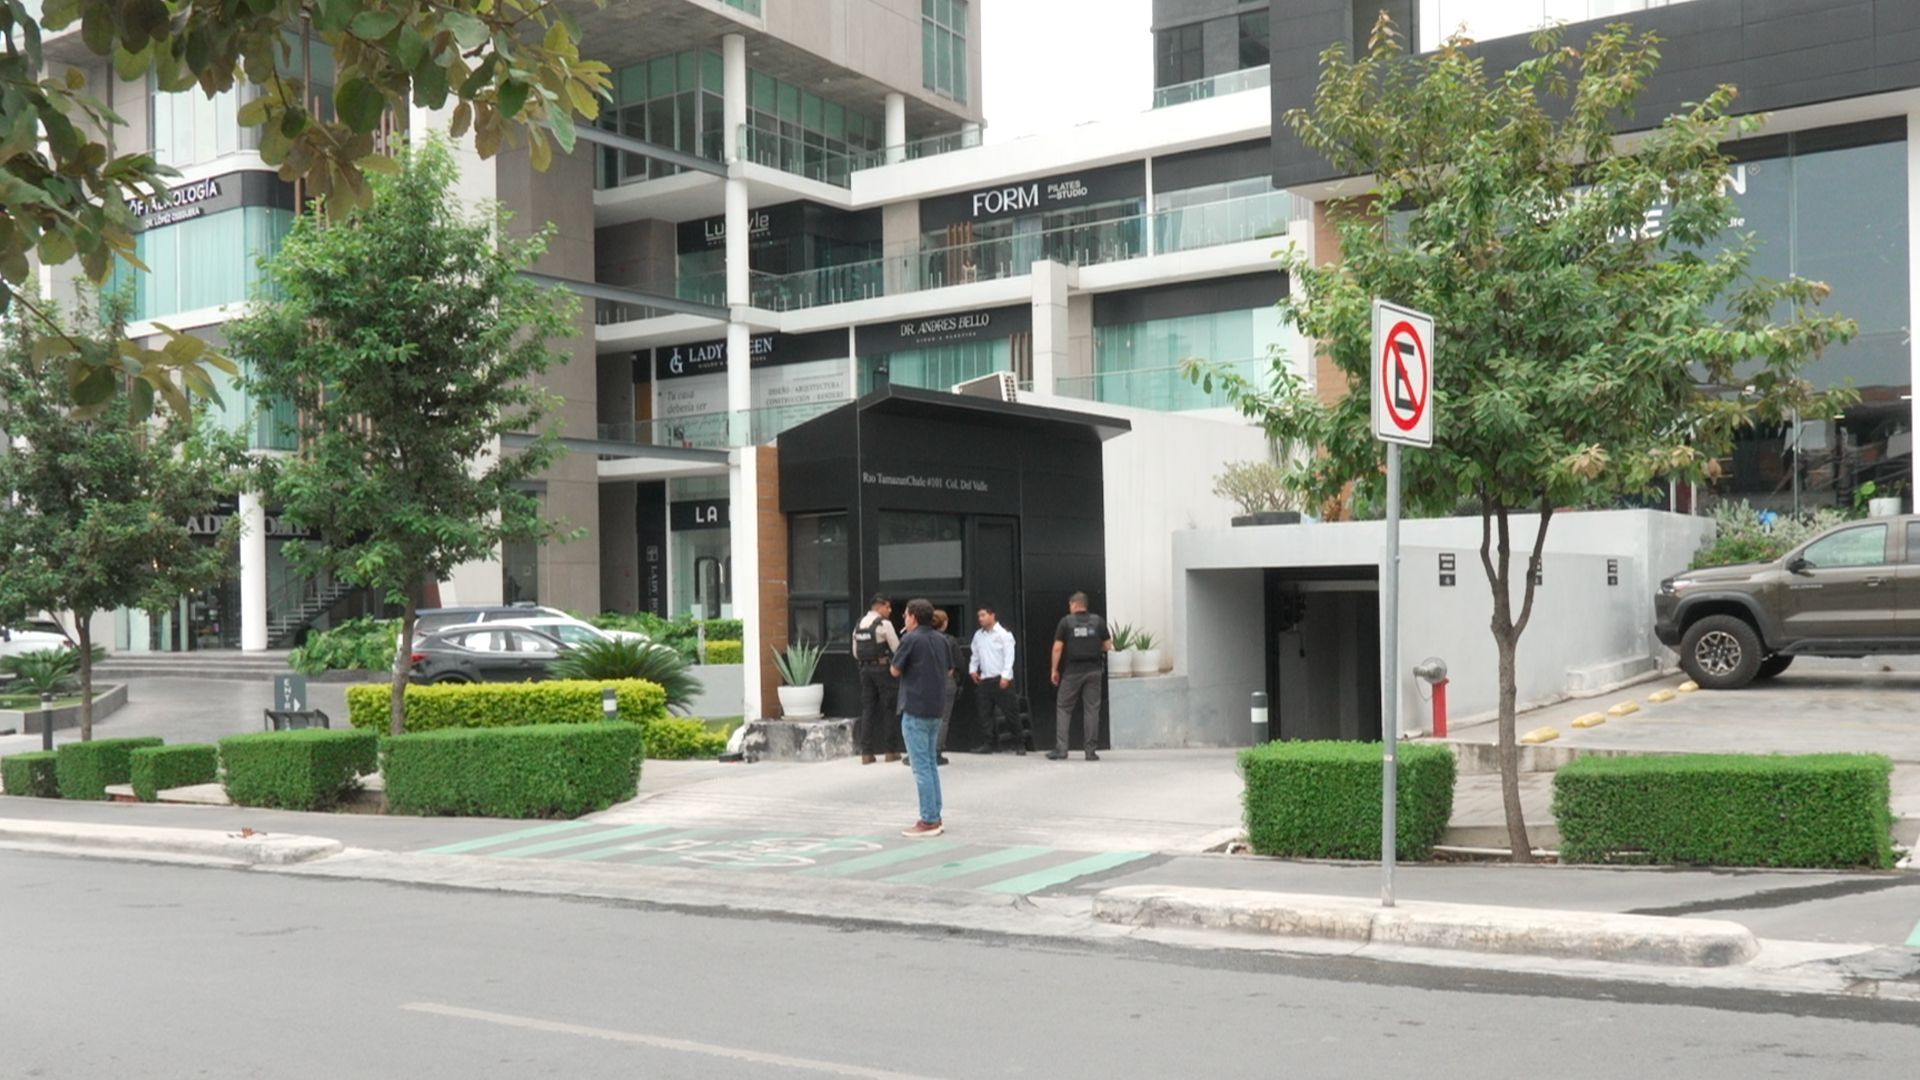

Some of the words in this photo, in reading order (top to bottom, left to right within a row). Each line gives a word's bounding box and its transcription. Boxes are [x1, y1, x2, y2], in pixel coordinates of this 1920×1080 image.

[1048, 180, 1081, 194] PILATES
[973, 184, 1039, 216] FORM
[959, 313, 990, 329] BELLO
[688, 343, 724, 363] LADY
[695, 506, 718, 523] LA
